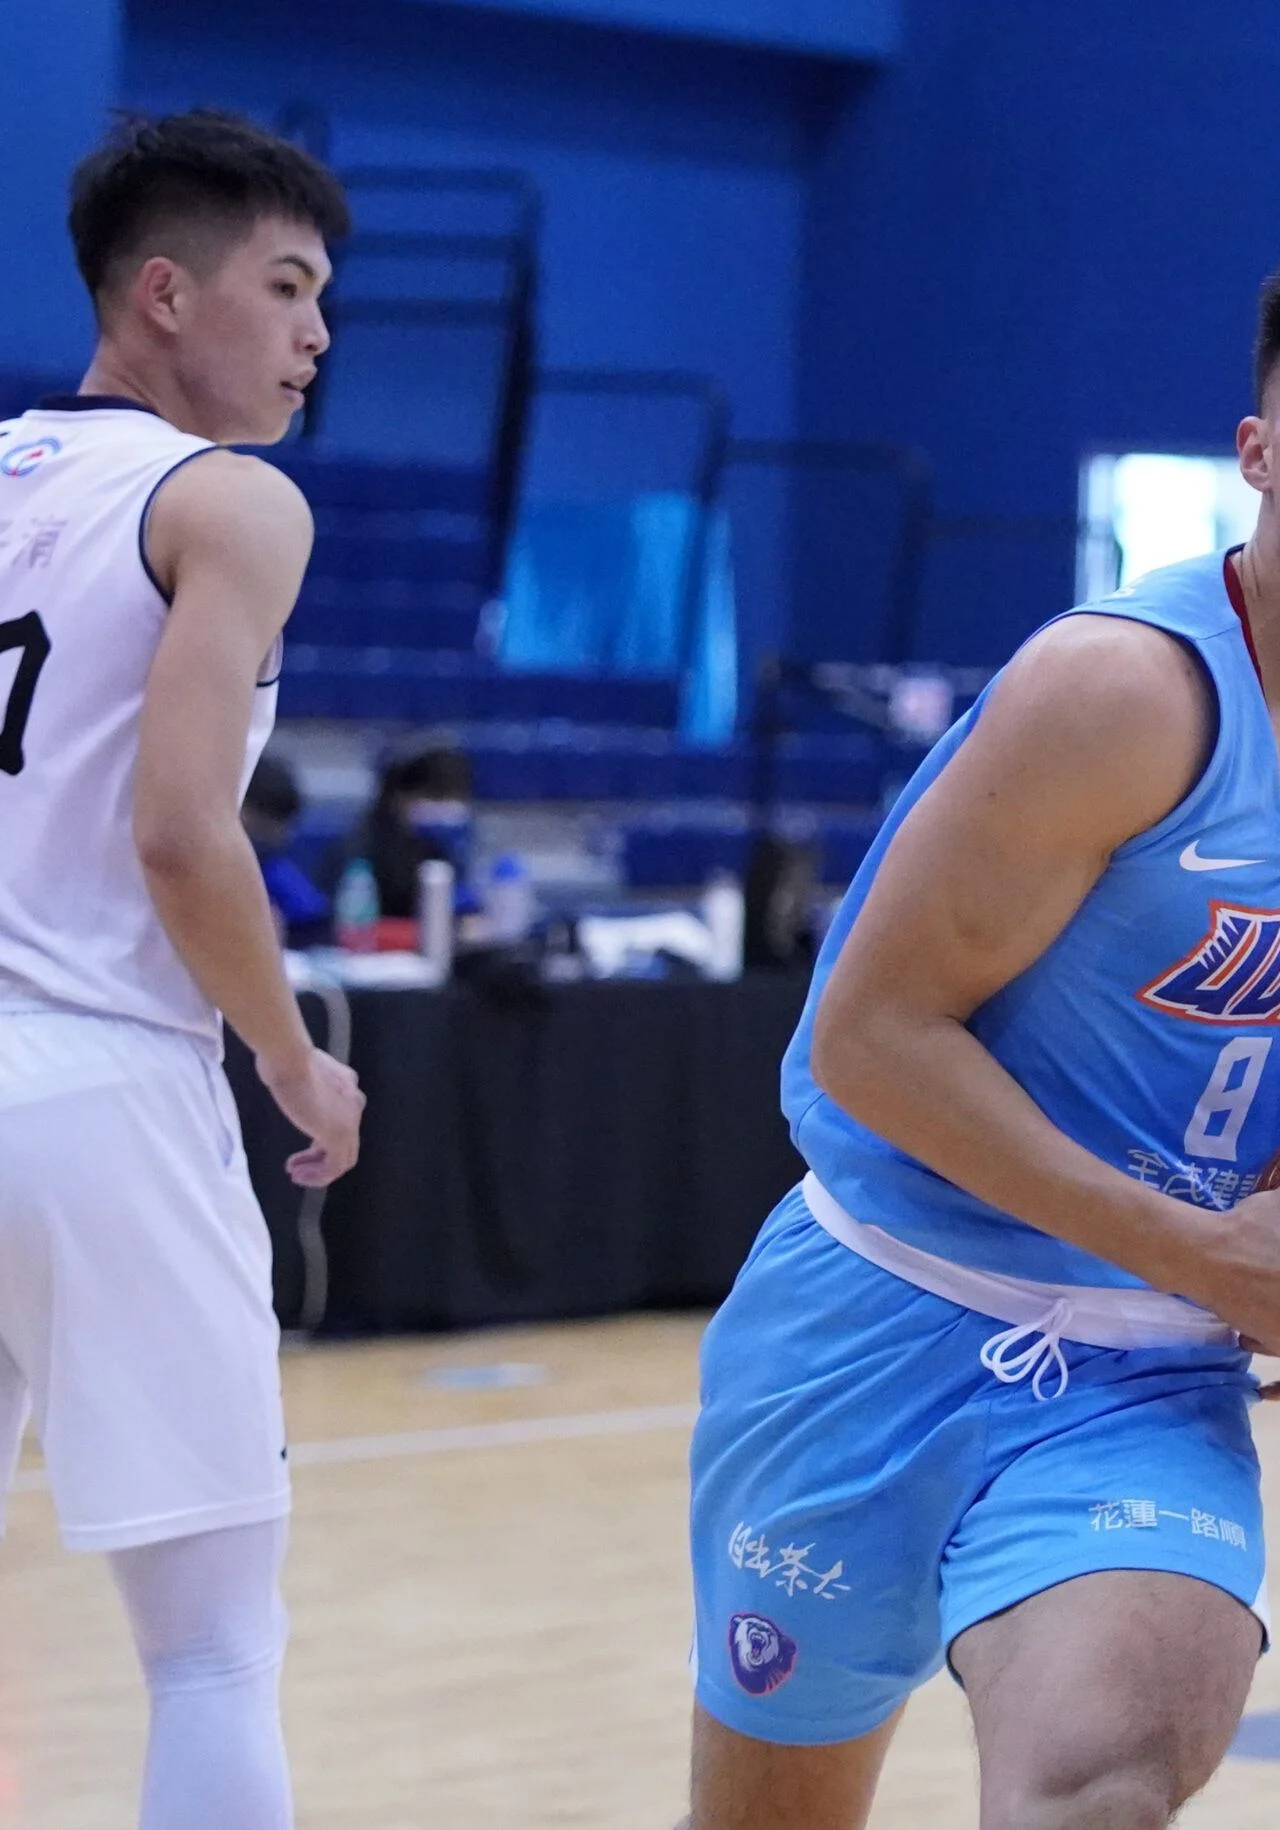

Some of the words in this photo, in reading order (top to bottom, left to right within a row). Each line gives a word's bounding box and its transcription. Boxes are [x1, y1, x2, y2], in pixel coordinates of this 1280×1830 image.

[1184, 1036, 1273, 1162] 8
[1088, 1499, 1248, 1552] 花蓮一路順
